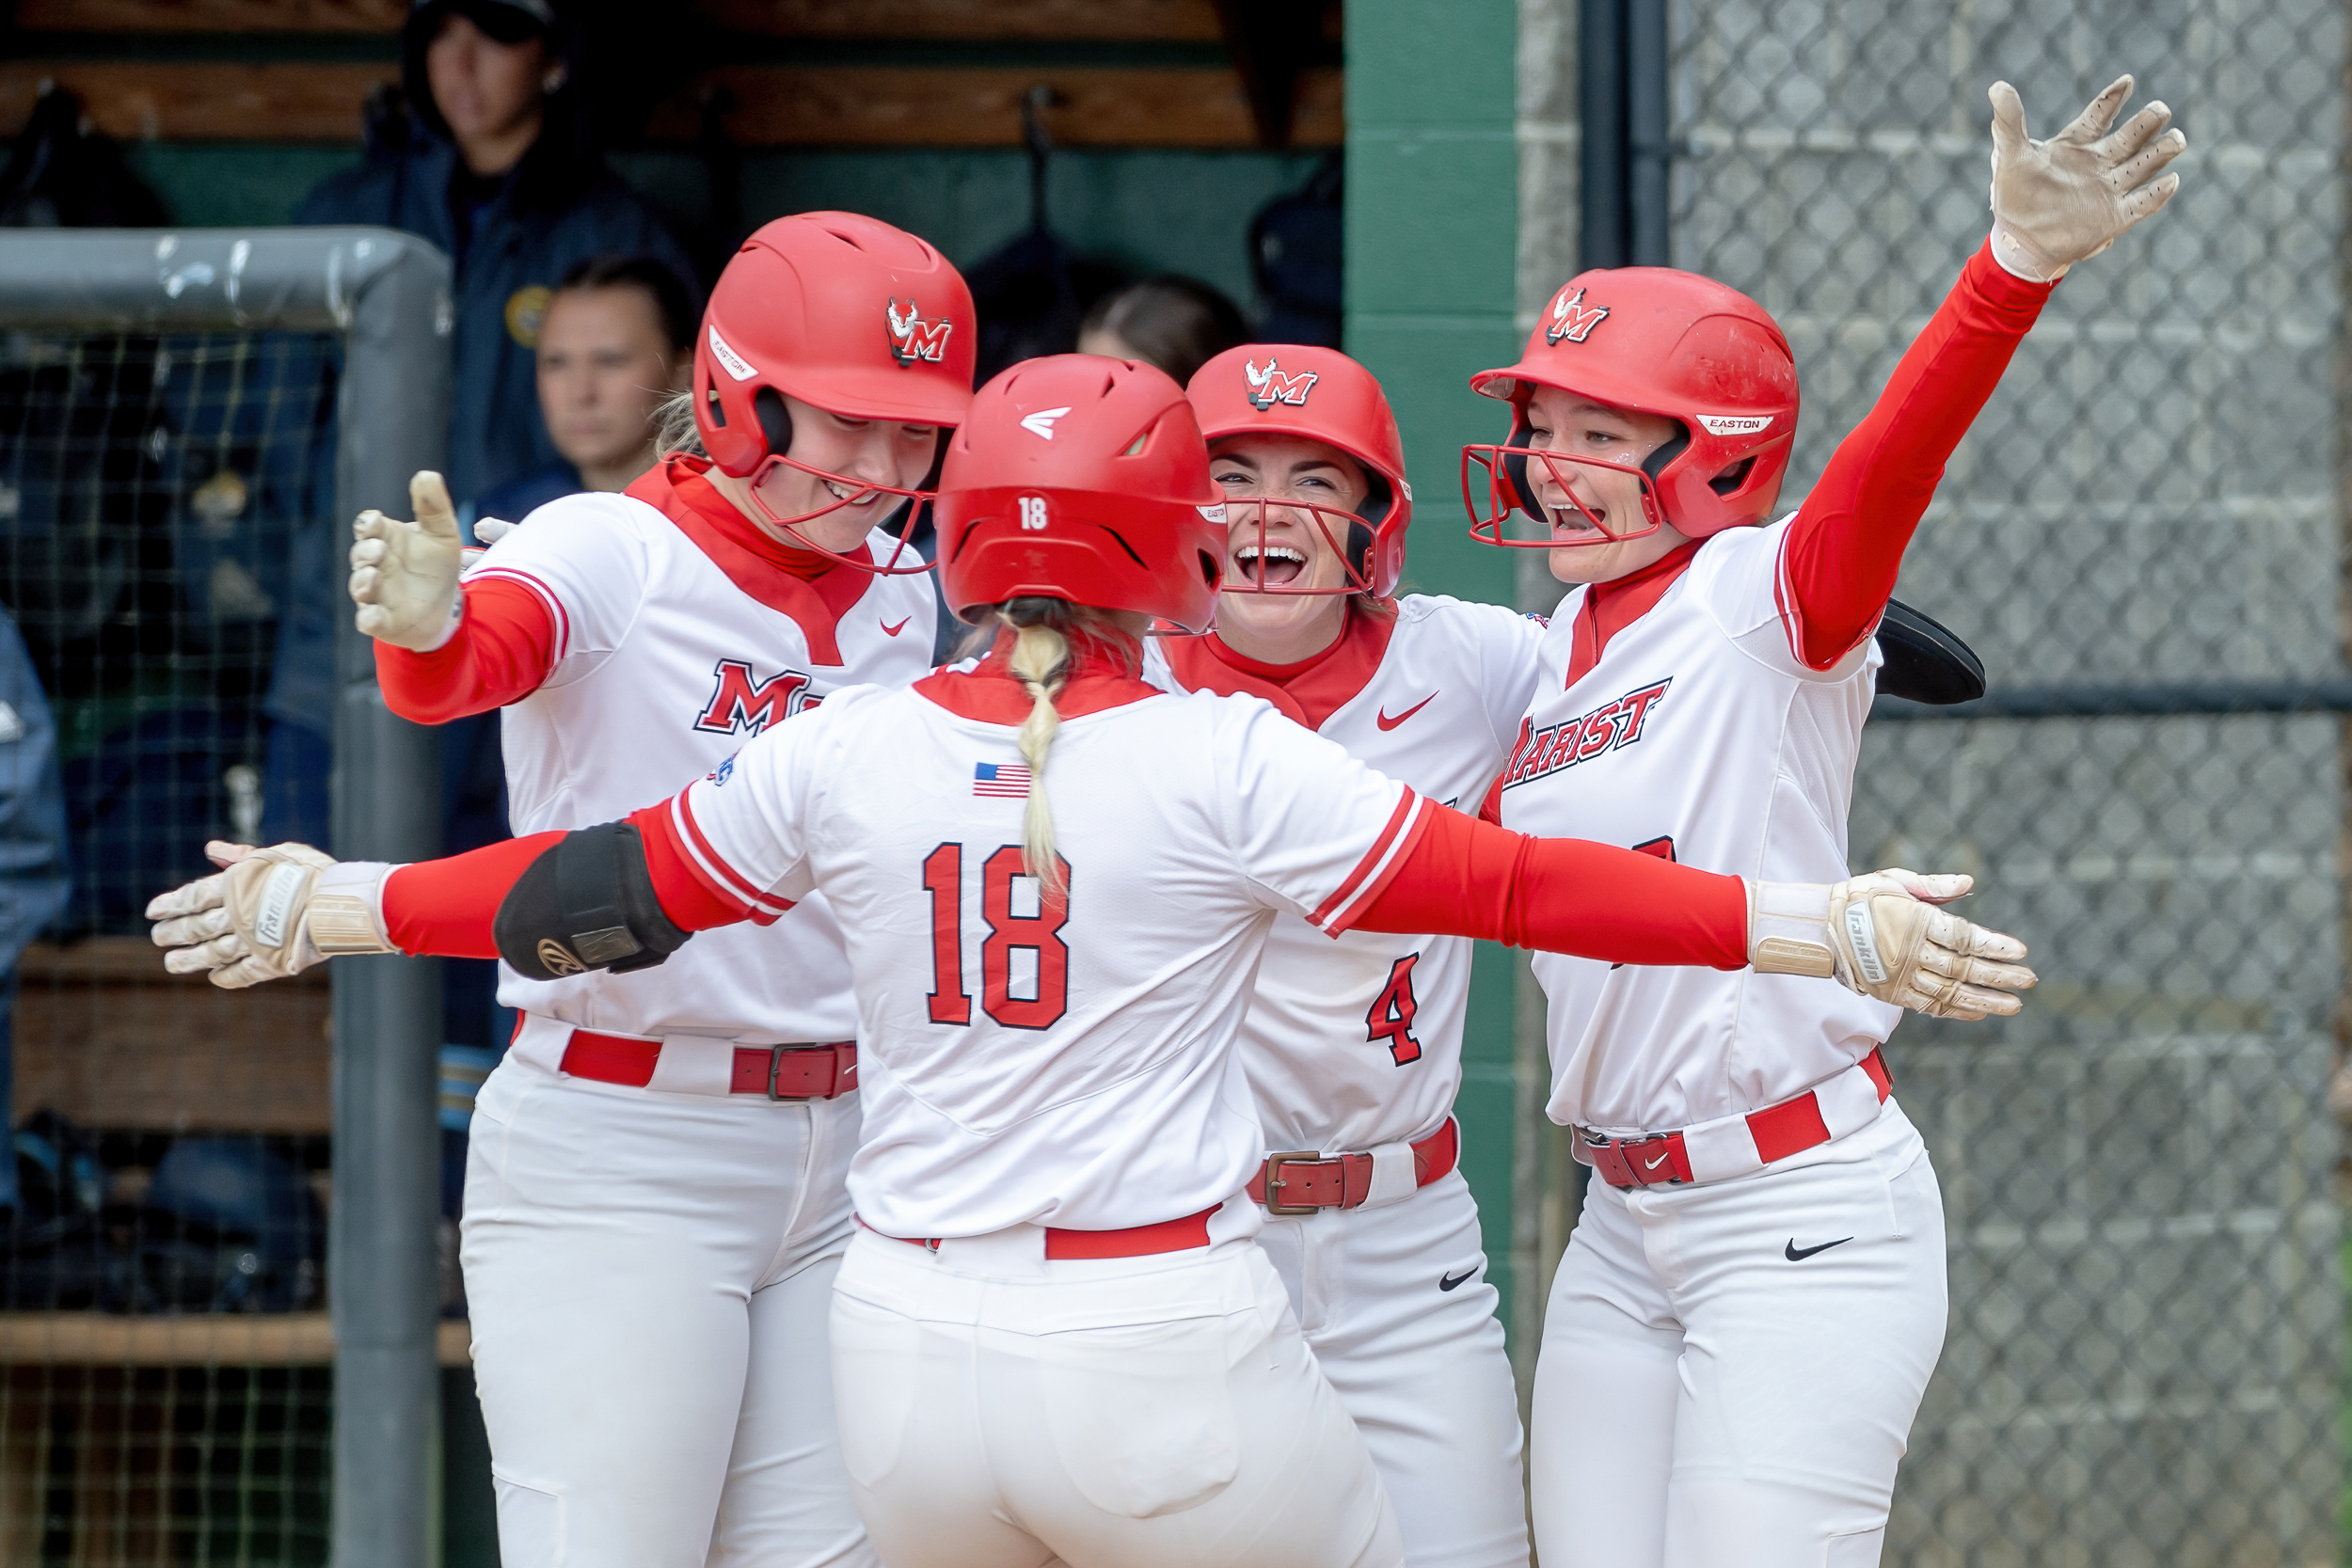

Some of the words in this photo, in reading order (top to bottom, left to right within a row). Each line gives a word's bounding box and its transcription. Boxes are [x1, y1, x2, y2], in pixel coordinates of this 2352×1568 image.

[1709, 419, 1759, 429] EASTON
[1018, 497, 1047, 531] 18
[921, 841, 1072, 1031] 18
[1365, 951, 1422, 1068] 4
